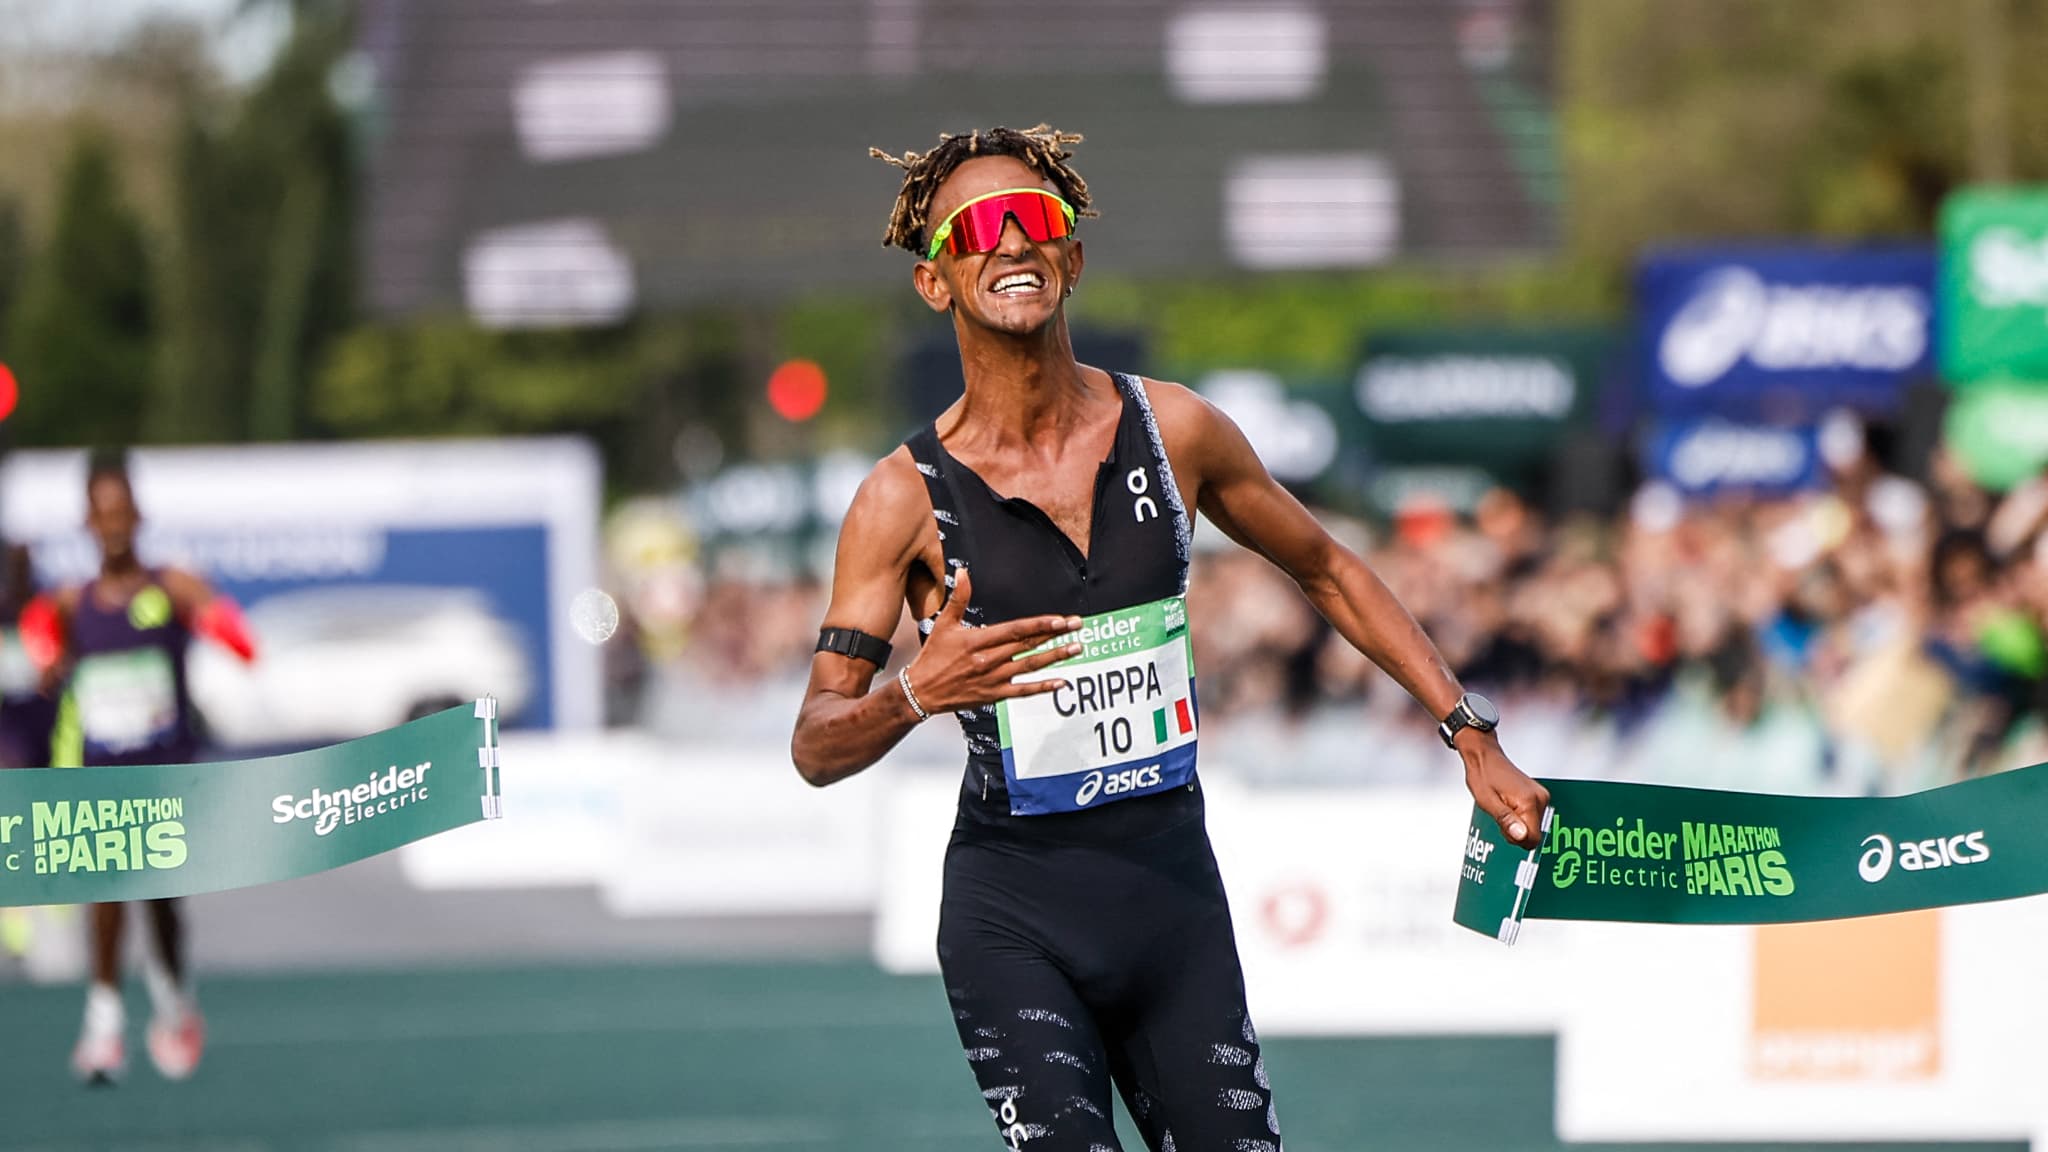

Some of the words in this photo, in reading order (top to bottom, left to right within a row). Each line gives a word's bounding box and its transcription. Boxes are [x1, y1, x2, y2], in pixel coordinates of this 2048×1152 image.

[1074, 636, 1141, 659] lectric
[1053, 661, 1162, 717] CRIPPA
[1094, 717, 1133, 758] 10
[272, 762, 431, 824] Schneider
[345, 787, 429, 825] Electric
[32, 798, 183, 841] MARATHON
[34, 842, 47, 874] DE
[50, 820, 187, 874] PARIS
[1682, 821, 1781, 861] MARATHON
[1899, 830, 1990, 871] asics
[1586, 860, 1679, 889] Electric
[1685, 863, 1696, 895] DE
[1694, 850, 1795, 896] PARIS
